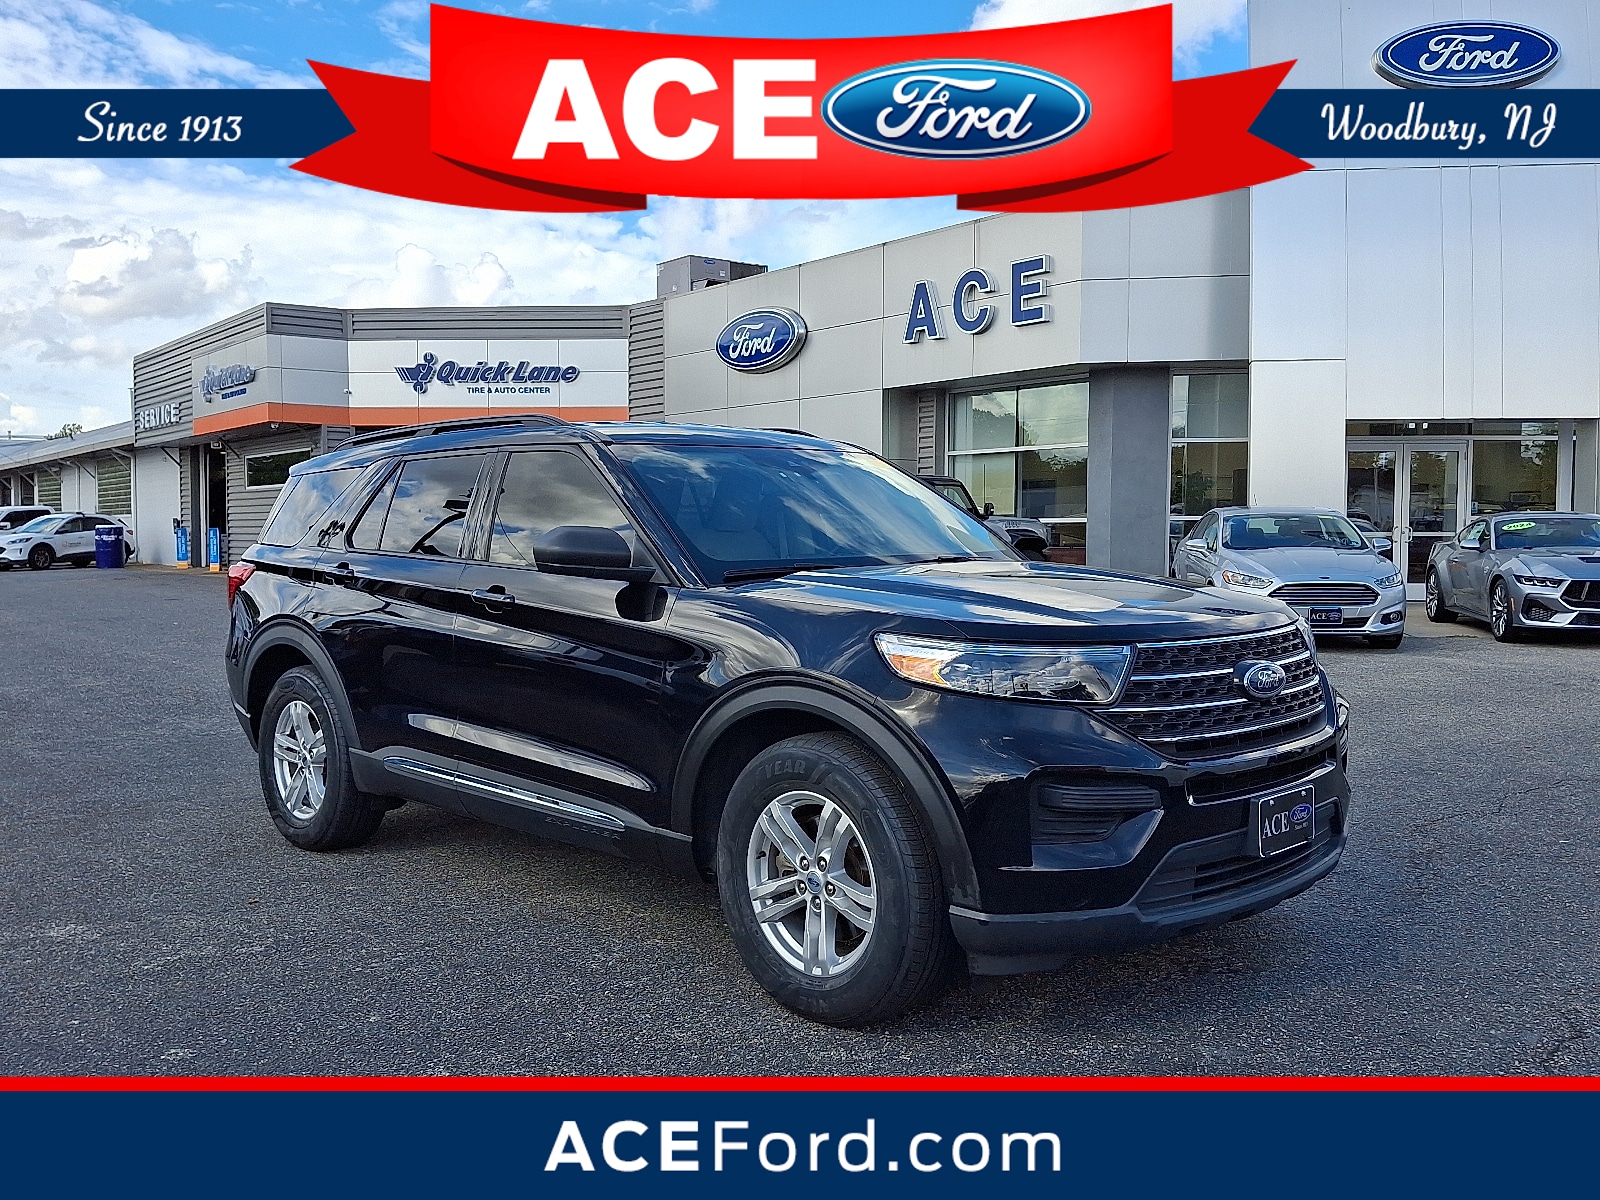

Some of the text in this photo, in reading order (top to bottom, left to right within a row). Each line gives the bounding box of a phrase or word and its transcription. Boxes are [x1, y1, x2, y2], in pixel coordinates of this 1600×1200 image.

[1418, 34, 1521, 72] Ford
[902, 254, 1052, 345] ACE
[729, 322, 775, 359] Ford
[436, 360, 580, 386] Quick Lane
[466, 386, 486, 394] TIRE
[494, 386, 517, 394] AUTO
[518, 386, 551, 394] CENTER
[139, 402, 180, 429] SERVICE
[1310, 612, 1328, 620] ACE
[1257, 670, 1280, 689] Ford
[1262, 811, 1290, 839] ACE
